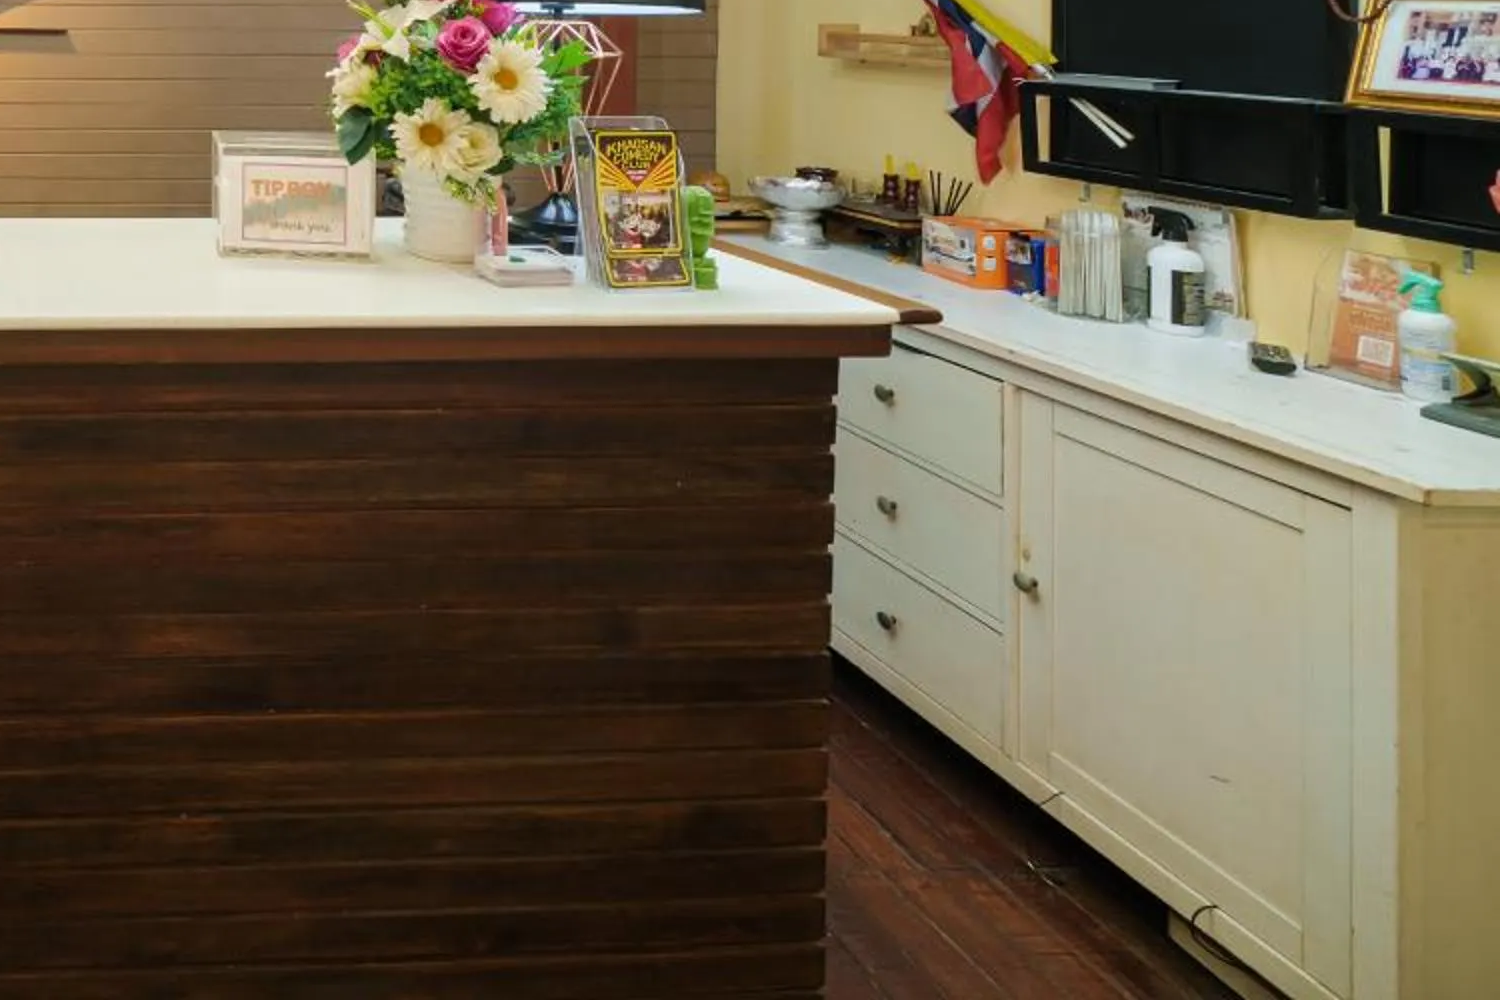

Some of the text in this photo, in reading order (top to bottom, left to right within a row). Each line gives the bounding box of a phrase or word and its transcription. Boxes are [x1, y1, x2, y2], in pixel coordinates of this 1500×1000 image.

[606, 139, 667, 157] KHAOSAN
[613, 149, 659, 164] COMEDY
[250, 179, 285, 197] TIP
